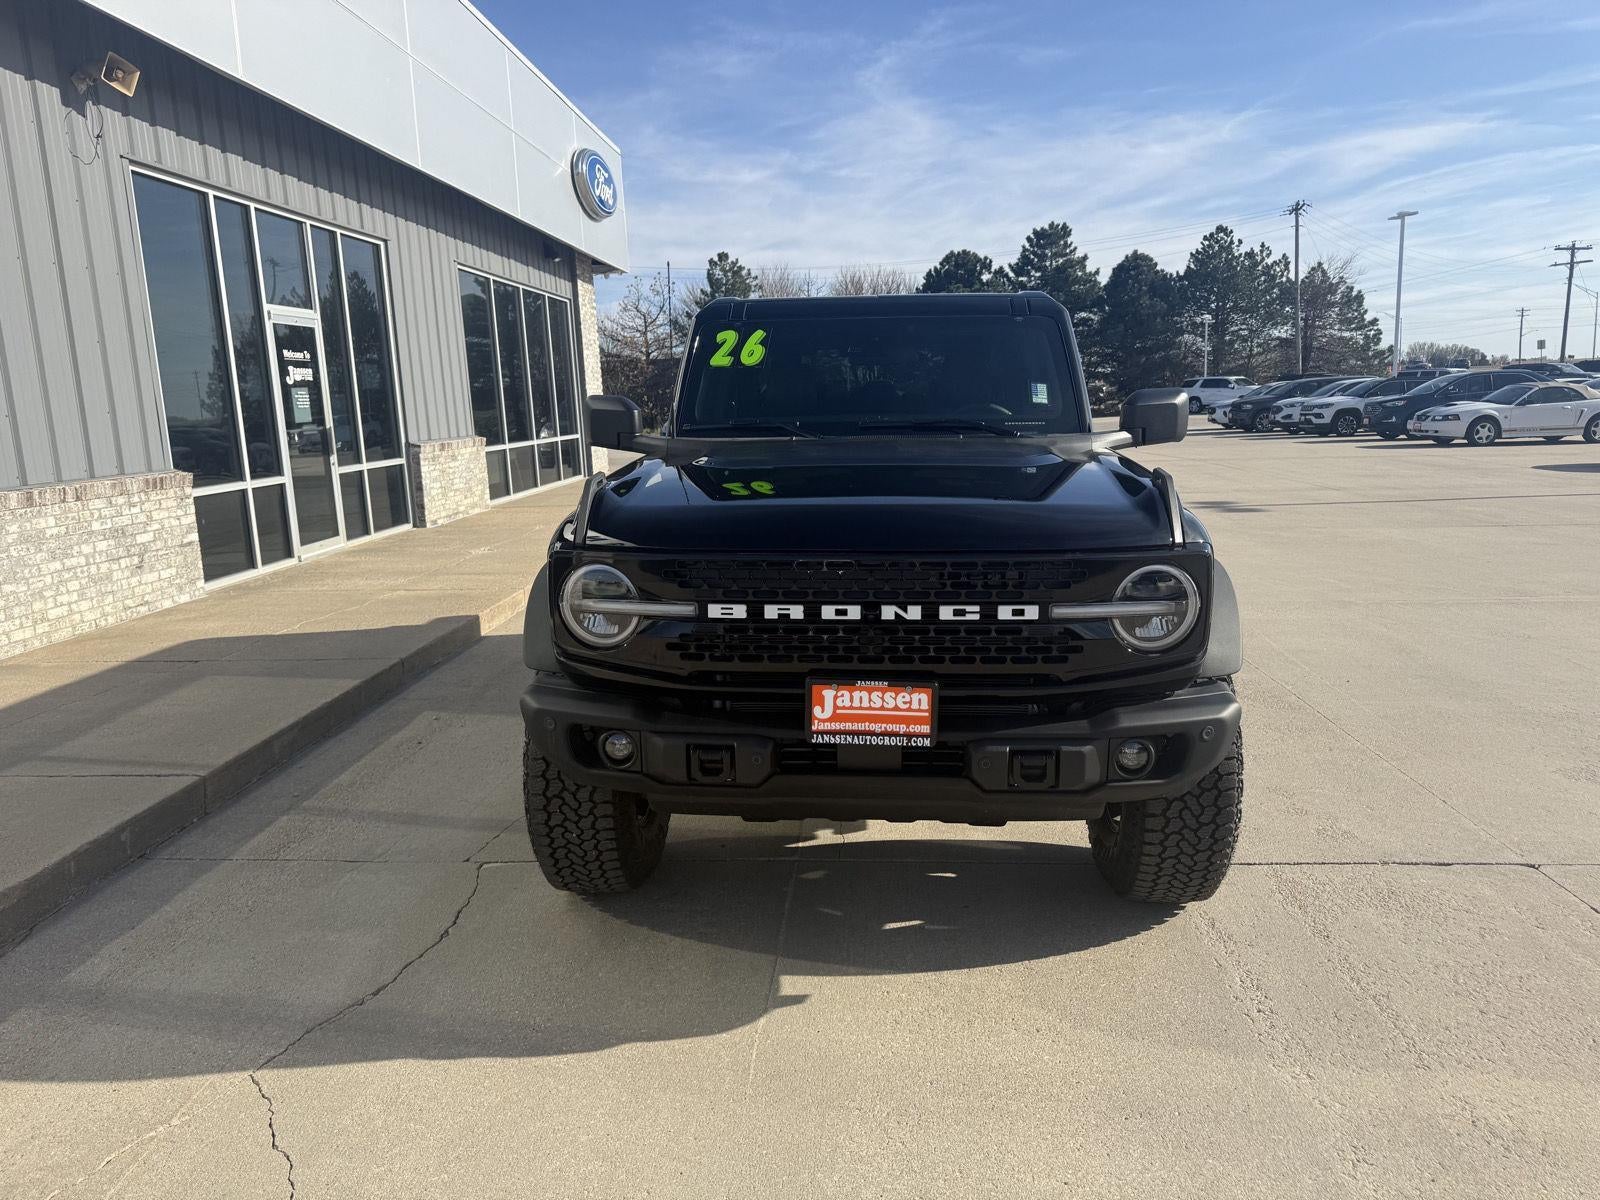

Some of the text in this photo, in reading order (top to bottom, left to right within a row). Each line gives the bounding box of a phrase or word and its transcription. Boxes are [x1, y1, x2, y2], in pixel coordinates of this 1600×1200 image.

[595, 164, 613, 206] Ford
[283, 349, 311, 359] Welcome To
[709, 329, 767, 367] 26
[707, 603, 1039, 620] BRONCO
[813, 689, 929, 719] Janssen
[812, 720, 930, 734] Janssenautogroup.com
